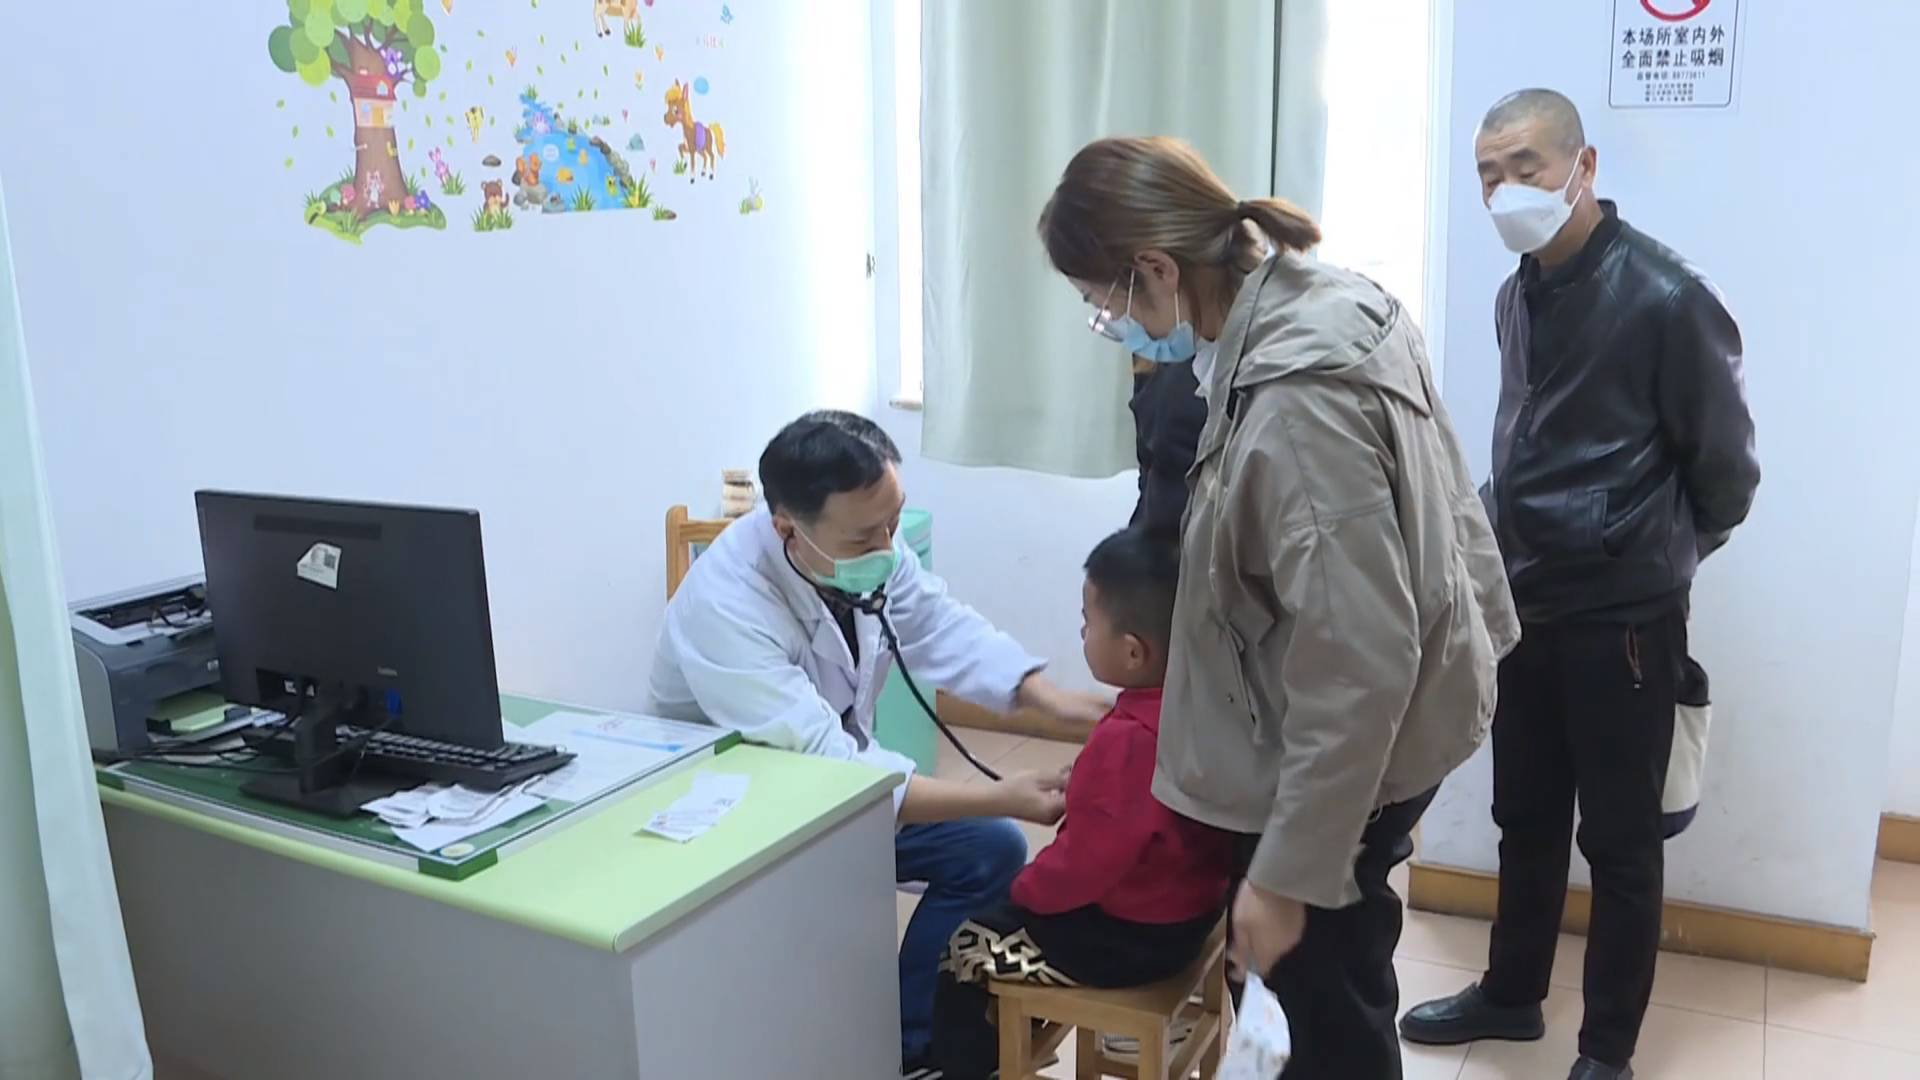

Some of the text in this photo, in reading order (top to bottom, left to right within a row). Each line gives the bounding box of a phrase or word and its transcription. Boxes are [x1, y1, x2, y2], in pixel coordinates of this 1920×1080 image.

[1622, 24, 1724, 46] 本场所室内外
[1622, 47, 1724, 68] 全面禁止吸烟
